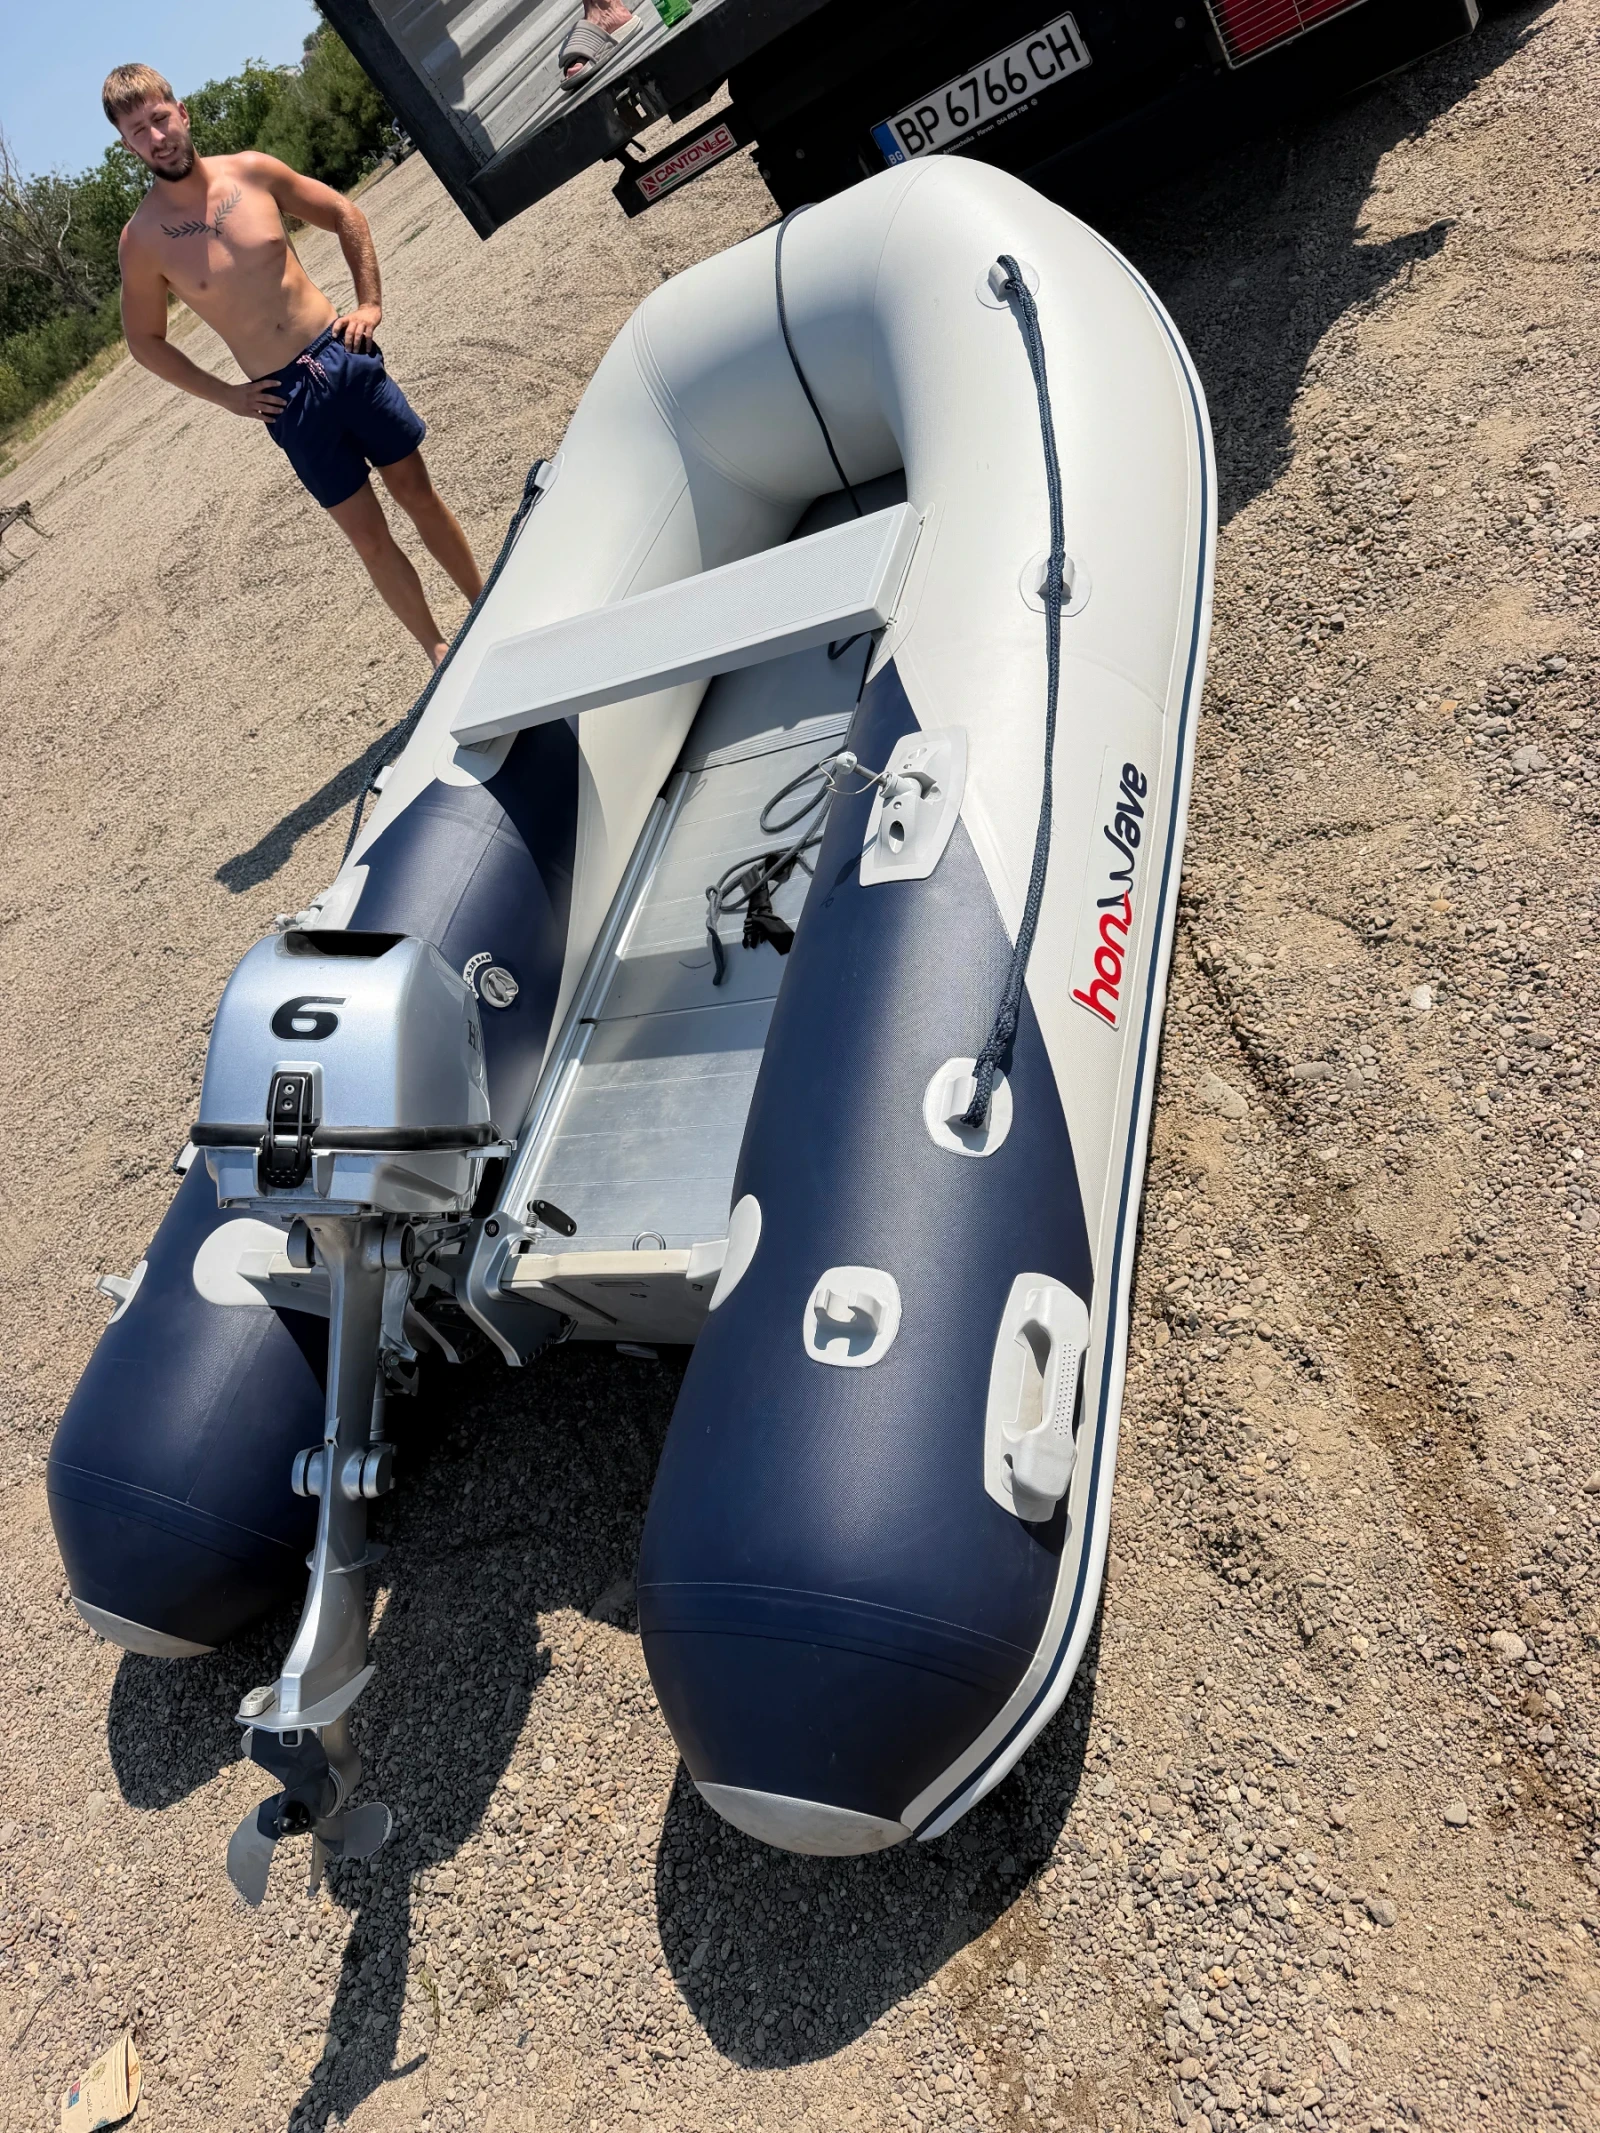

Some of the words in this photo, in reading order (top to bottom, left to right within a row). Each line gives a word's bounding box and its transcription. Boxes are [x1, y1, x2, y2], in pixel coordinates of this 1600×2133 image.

[894, 105, 940, 156] BP
[945, 56, 1028, 127] 6766
[1026, 24, 1082, 80] CH
[888, 150, 903, 166] BG
[475, 954, 491, 963] BAR
[270, 994, 349, 1041] 6
